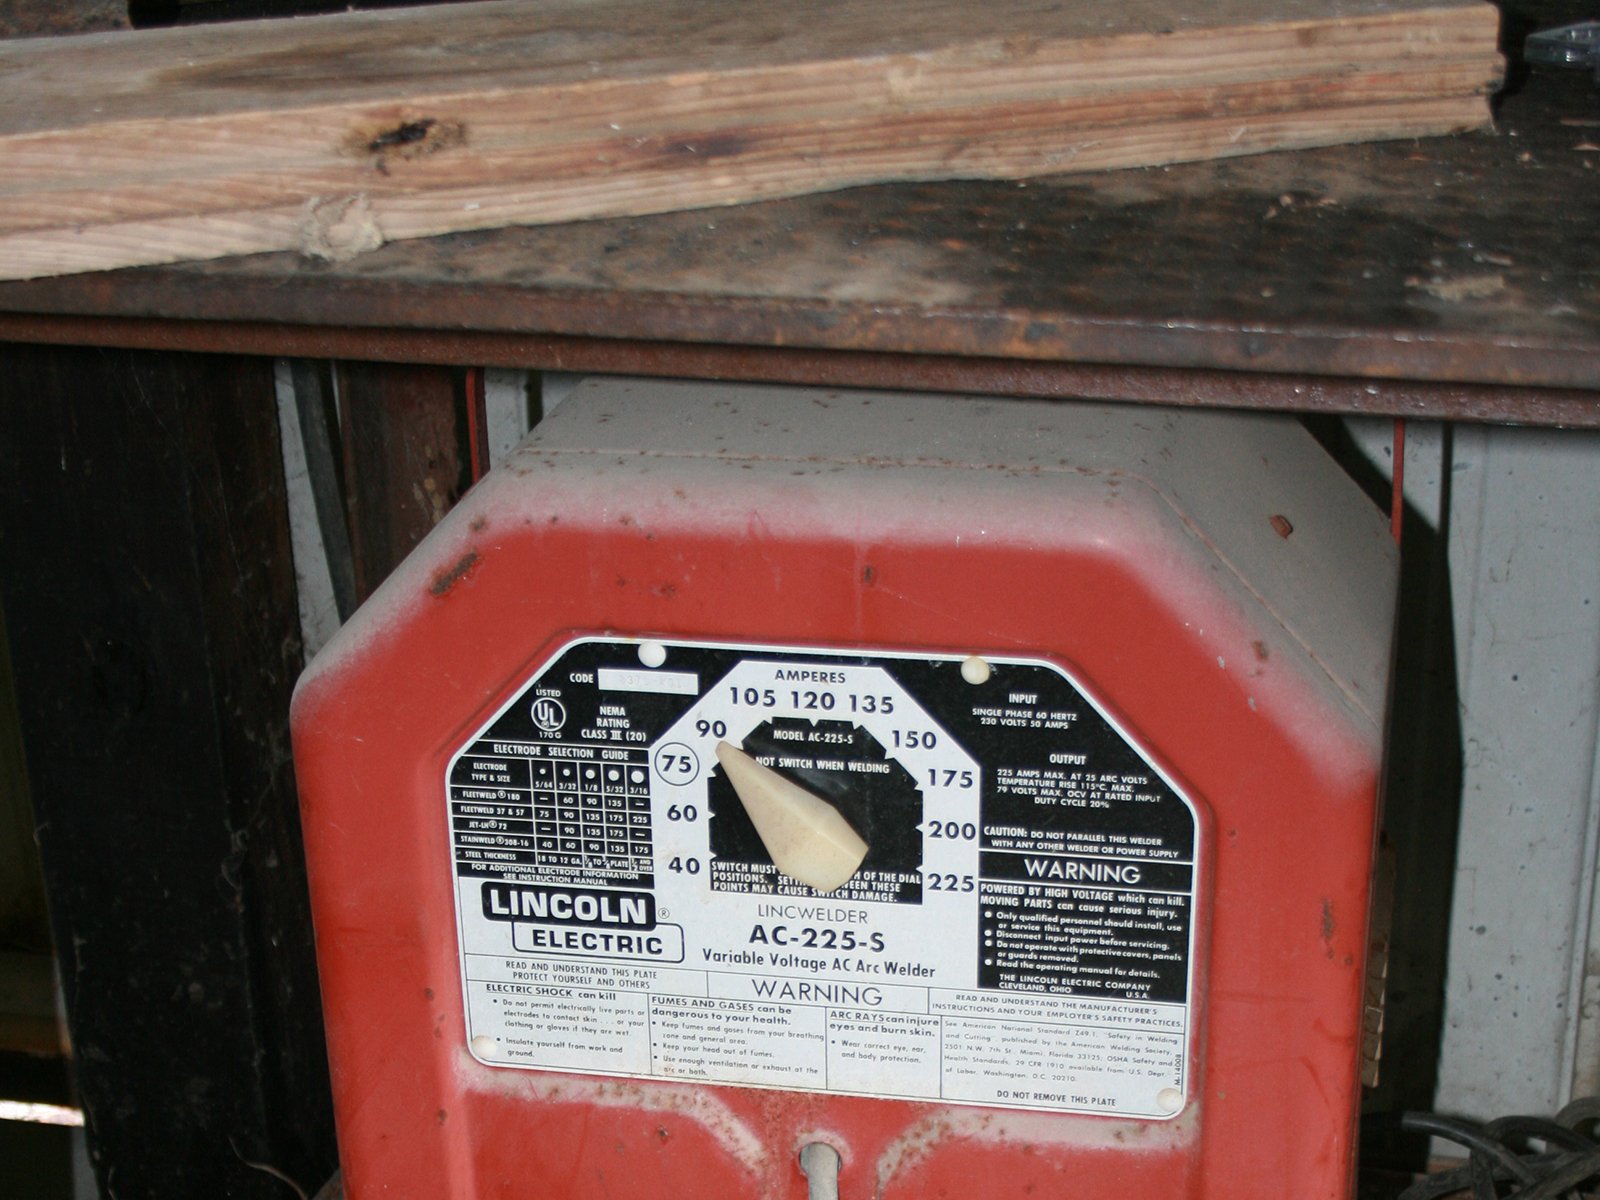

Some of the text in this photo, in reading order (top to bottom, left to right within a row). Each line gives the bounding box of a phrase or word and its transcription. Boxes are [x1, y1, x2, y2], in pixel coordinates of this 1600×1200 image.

[570, 674, 593, 683] CODE
[775, 670, 845, 683] AMPERES
[536, 689, 561, 697] LISTED
[731, 687, 893, 714] 105 120 135
[1009, 694, 1037, 704] INPUT
[538, 703, 559, 726] UL
[600, 706, 625, 716] NEMA
[972, 708, 1001, 716] SINGLE
[1006, 710, 1032, 718] PHASE
[1051, 712, 1077, 721] HERTZ
[597, 718, 629, 728] RATING
[696, 720, 726, 738] 90
[1001, 718, 1026, 727] VOLTS
[1045, 721, 1068, 729] AMPS
[581, 730, 646, 741] CLASS III (20)
[774, 730, 853, 744] MODEL AC-225-S
[892, 730, 936, 750] 150
[494, 744, 628, 760] ELECTRODE SELECTION GUIDE
[1050, 754, 1086, 764] OUTPUT
[662, 755, 691, 773] 75
[779, 758, 890, 773] SWITCH WHEN WELDING
[928, 769, 973, 789] 175
[998, 769, 1012, 777] 225
[1017, 770, 1040, 778] AMPS
[1044, 771, 1066, 779] MAX.
[1121, 776, 1148, 784] VOLTS
[1035, 797, 1056, 805] DUTY
[1061, 799, 1086, 807] CYCLE
[667, 805, 697, 822] 60
[928, 821, 976, 839] 200
[984, 826, 1027, 838] CAUTION:
[1046, 832, 1064, 840] NOT
[1067, 833, 1105, 842] PARALLEL
[1130, 837, 1161, 845] WELDER
[1016, 841, 1033, 849] ANY
[1037, 842, 1064, 850] OTHER
[1067, 844, 1099, 853] WELDER
[1116, 847, 1145, 856] POWER
[1149, 849, 1178, 858] SUPPLY
[489, 865, 536, 874] ADDITIONAL
[538, 868, 580, 877] ELECTRODE
[583, 871, 638, 880] INFORMATION
[669, 857, 700, 875] 40
[712, 862, 920, 884] SWITCH MUST OF THE DIAL
[1024, 859, 1140, 884] WARNING
[519, 874, 571, 883] INSTRUCTION
[574, 878, 607, 886] MANUAL
[713, 872, 900, 892] POSITIONS. THESE
[928, 874, 974, 892] 225
[714, 882, 896, 902] POINTS MAY CAUSE DAMAGE.
[981, 883, 1184, 906] POWERED BY HIGH VOLTAGE which can kill.
[490, 889, 646, 924] LINCOLN
[758, 904, 868, 924] LINCWELDER
[980, 895, 1178, 919] MOVING PARTS cause serious injury.
[532, 929, 663, 955] ELECTRIC
[750, 924, 885, 952] AC-225-S
[506, 961, 656, 979] READ AND UNDERSTAND THIS PLATE
[703, 948, 935, 978] Variable Voltage AC Arc Welder
[513, 972, 650, 989] PROTECT YOURSELF AND OTHERS
[999, 982, 1071, 993] CLEVELAND, OHIO
[1020, 975, 1057, 984] LINCOLN
[1062, 978, 1101, 988] ELECTRIC
[1105, 982, 1150, 991] COMPANY
[486, 984, 532, 994] ELECTRIC
[536, 987, 572, 997] SHOCK
[599, 992, 616, 1000] kill
[752, 979, 882, 1006] WARNING
[652, 997, 791, 1014] FUMES AND GASES can be
[652, 1008, 709, 1019] dangerous
[725, 1015, 750, 1023] your
[753, 1016, 791, 1025] health.
[830, 1011, 851, 1019] ARC
[855, 1013, 884, 1022] RAYS
[906, 1016, 939, 1026] injure
[830, 1023, 854, 1031] eyes
[881, 1026, 906, 1035] burn
[910, 1029, 935, 1037] skin.
[997, 1090, 1116, 1106] DO NOT REMOVE THIS PLATE
